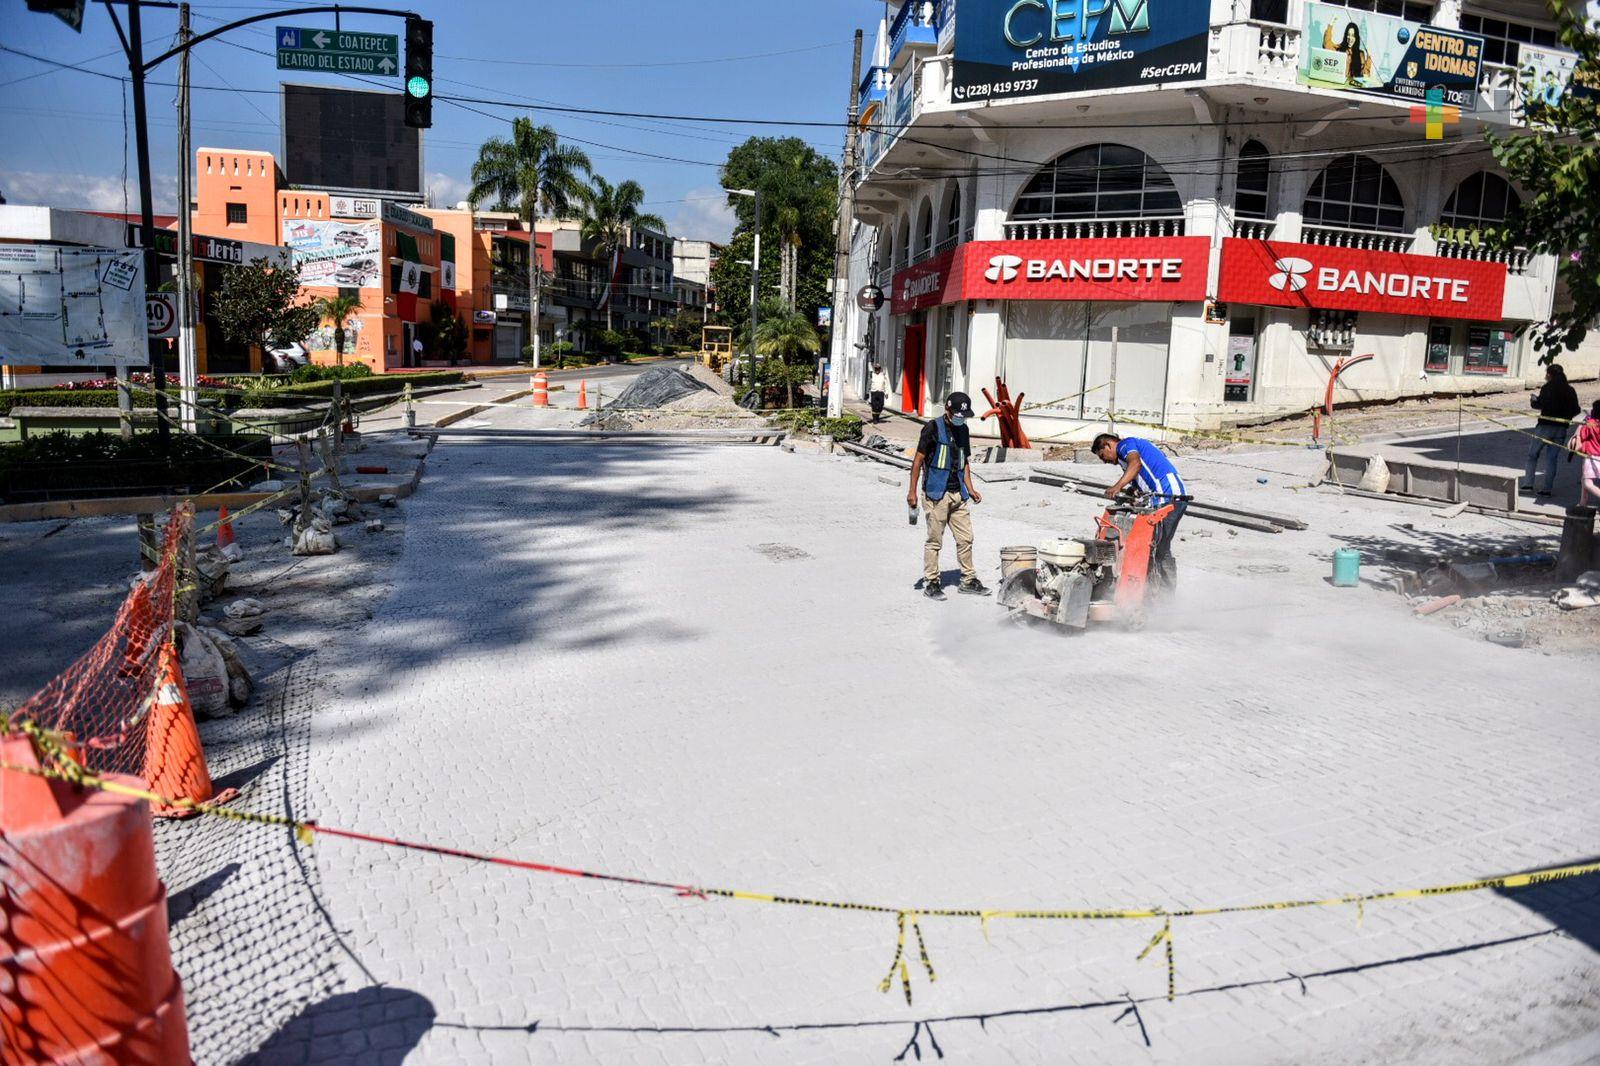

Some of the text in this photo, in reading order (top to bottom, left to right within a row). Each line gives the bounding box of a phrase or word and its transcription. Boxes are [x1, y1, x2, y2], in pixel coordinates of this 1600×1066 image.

[1003, 0, 1151, 47] CEPM
[339, 35, 388, 51] COATEPEC
[1025, 40, 1121, 59] Centro de Estudios
[1415, 31, 1479, 57] CENTRO DE
[280, 52, 374, 71] TEATRO DEL ESTADO
[1012, 49, 1135, 71] Profesionales de México
[1323, 58, 1339, 67] SEP
[1424, 53, 1477, 78] IDIOMAS
[1140, 62, 1202, 79] #SerCEPM
[966, 79, 1039, 98] (228) 419 9737
[1394, 85, 1425, 97] CAMBRIDGE
[1447, 90, 1472, 104] TOEFL
[1026, 258, 1183, 281] BANORTE
[1317, 266, 1470, 302] BANORTE
